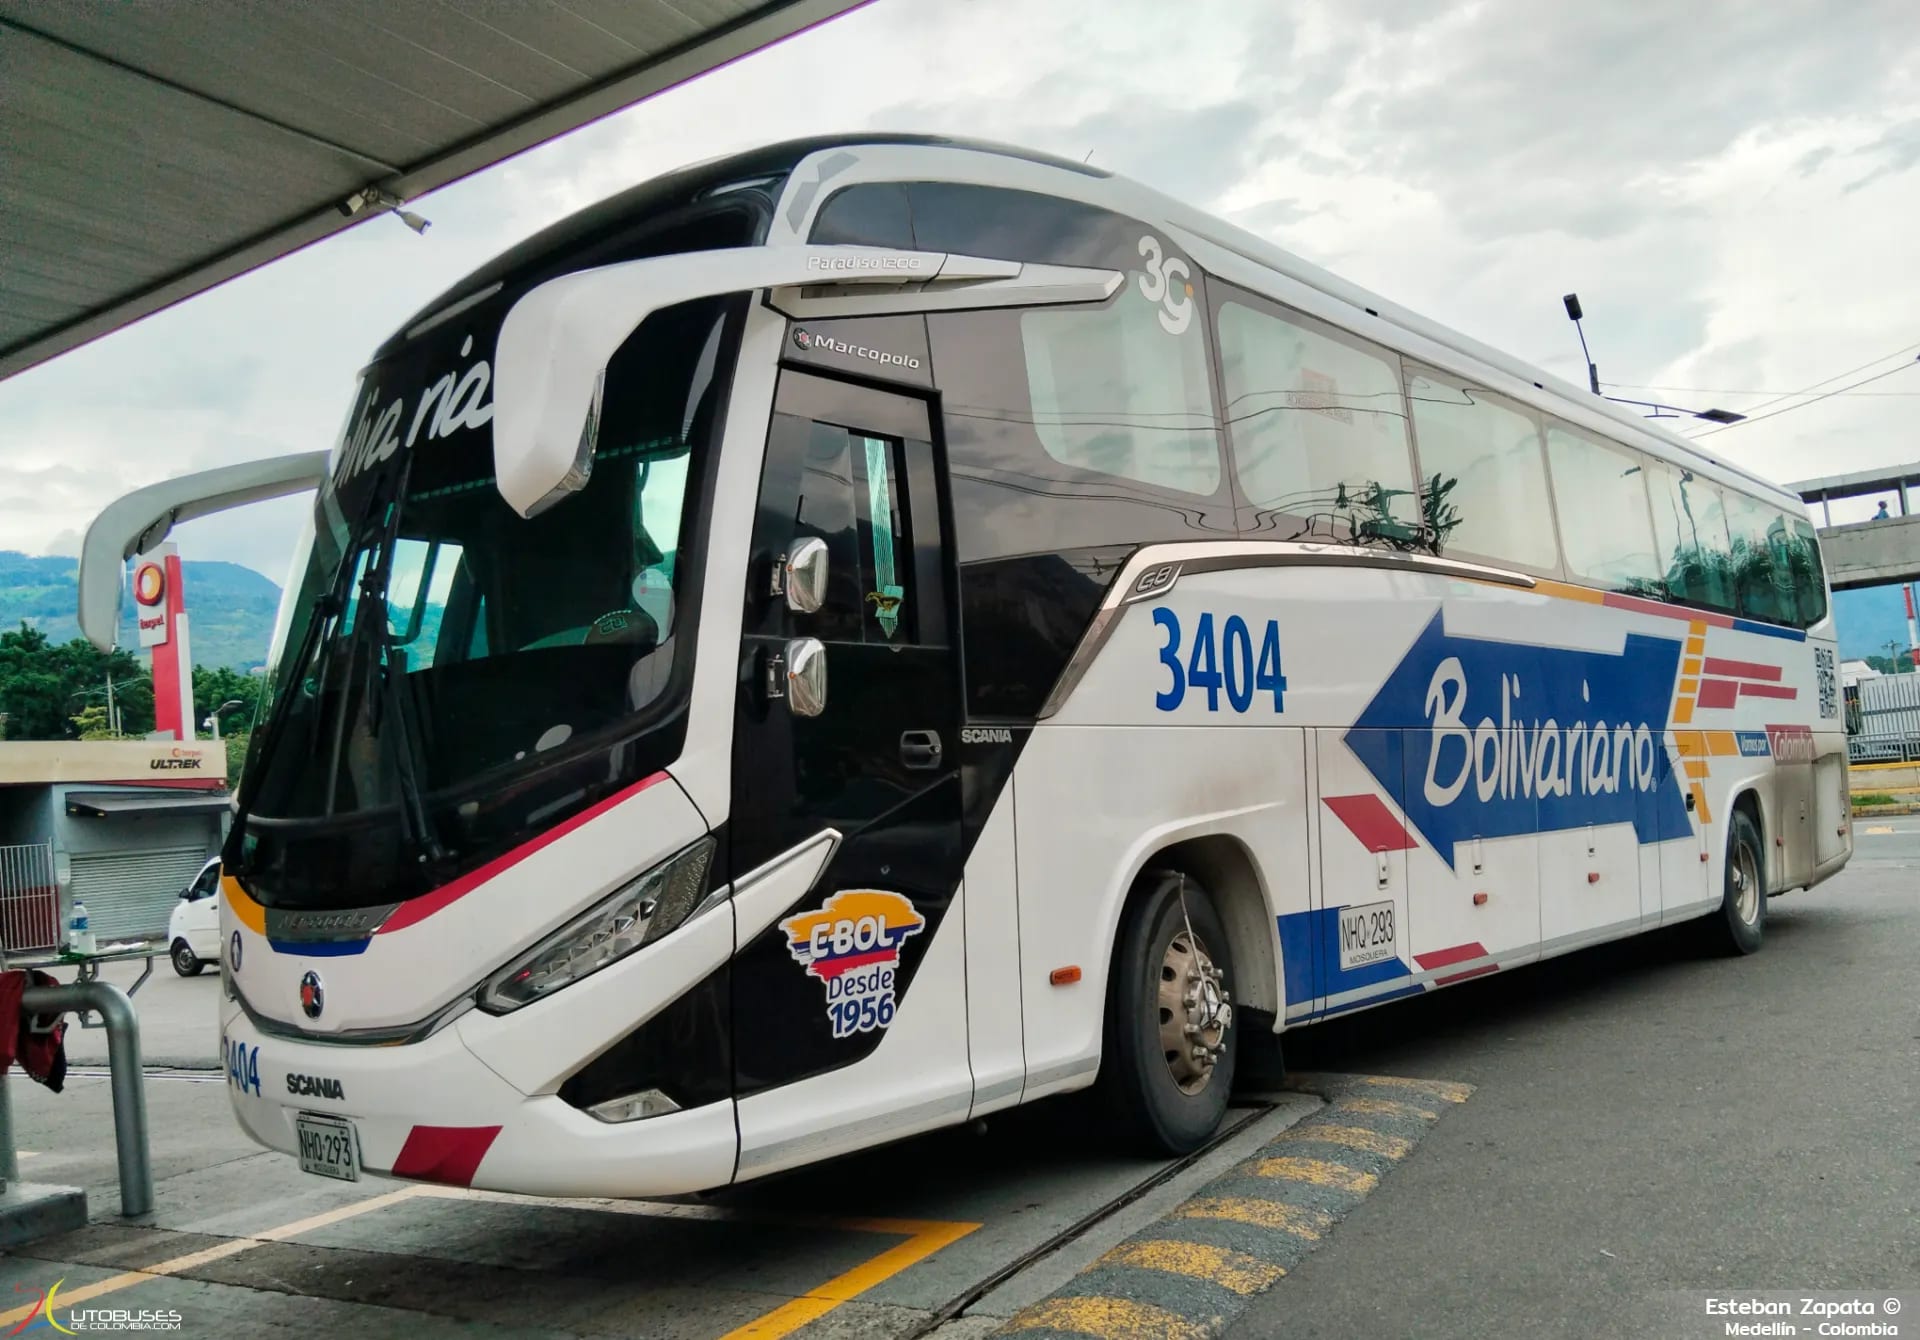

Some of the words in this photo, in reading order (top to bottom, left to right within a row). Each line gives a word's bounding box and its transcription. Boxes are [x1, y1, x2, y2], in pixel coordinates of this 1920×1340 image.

[807, 256, 879, 270] Paradiso
[883, 257, 921, 269] 1200
[814, 334, 920, 369] Marcopolo
[1136, 566, 1173, 591] G8
[1152, 607, 1287, 713] 3404
[961, 729, 1012, 743] SCANIA
[1423, 656, 1654, 807] Bolivariano
[150, 759, 201, 769] ULTREK
[1349, 949, 1387, 964] MOSQUERA
[828, 966, 893, 1000] Desde
[830, 993, 894, 1034] 1956
[286, 1073, 345, 1100] SCANIA
